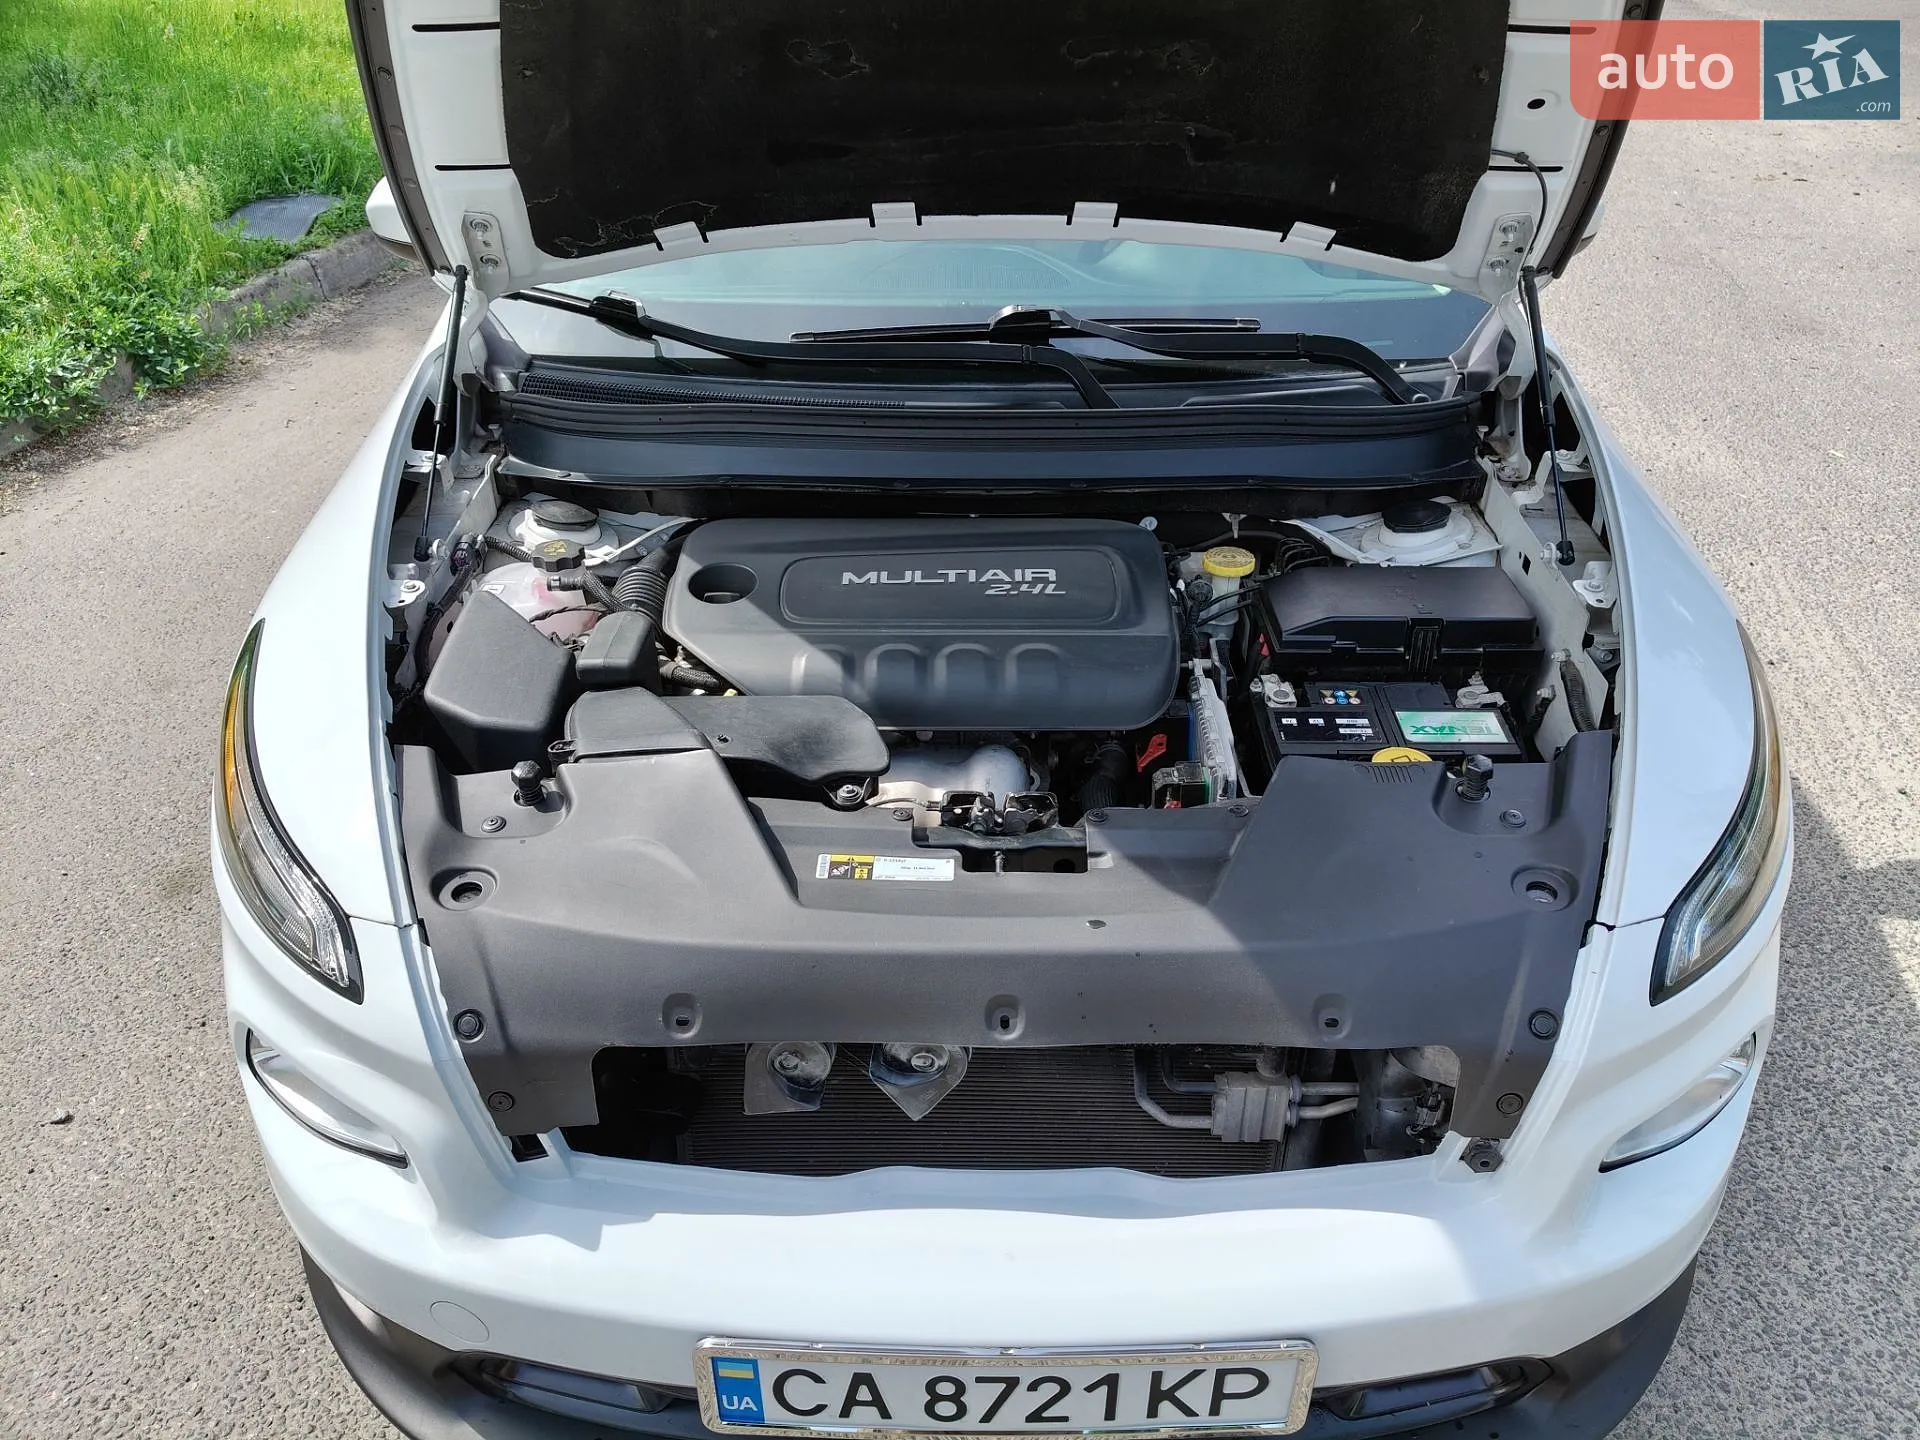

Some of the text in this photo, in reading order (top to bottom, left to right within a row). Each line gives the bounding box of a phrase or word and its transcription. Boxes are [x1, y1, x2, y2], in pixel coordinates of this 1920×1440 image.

[841, 568, 1057, 585] MULTIAIR
[984, 584, 1067, 595] 2.4L
[773, 1366, 1270, 1424] CA 8721 KP
[722, 1396, 758, 1412] UA
